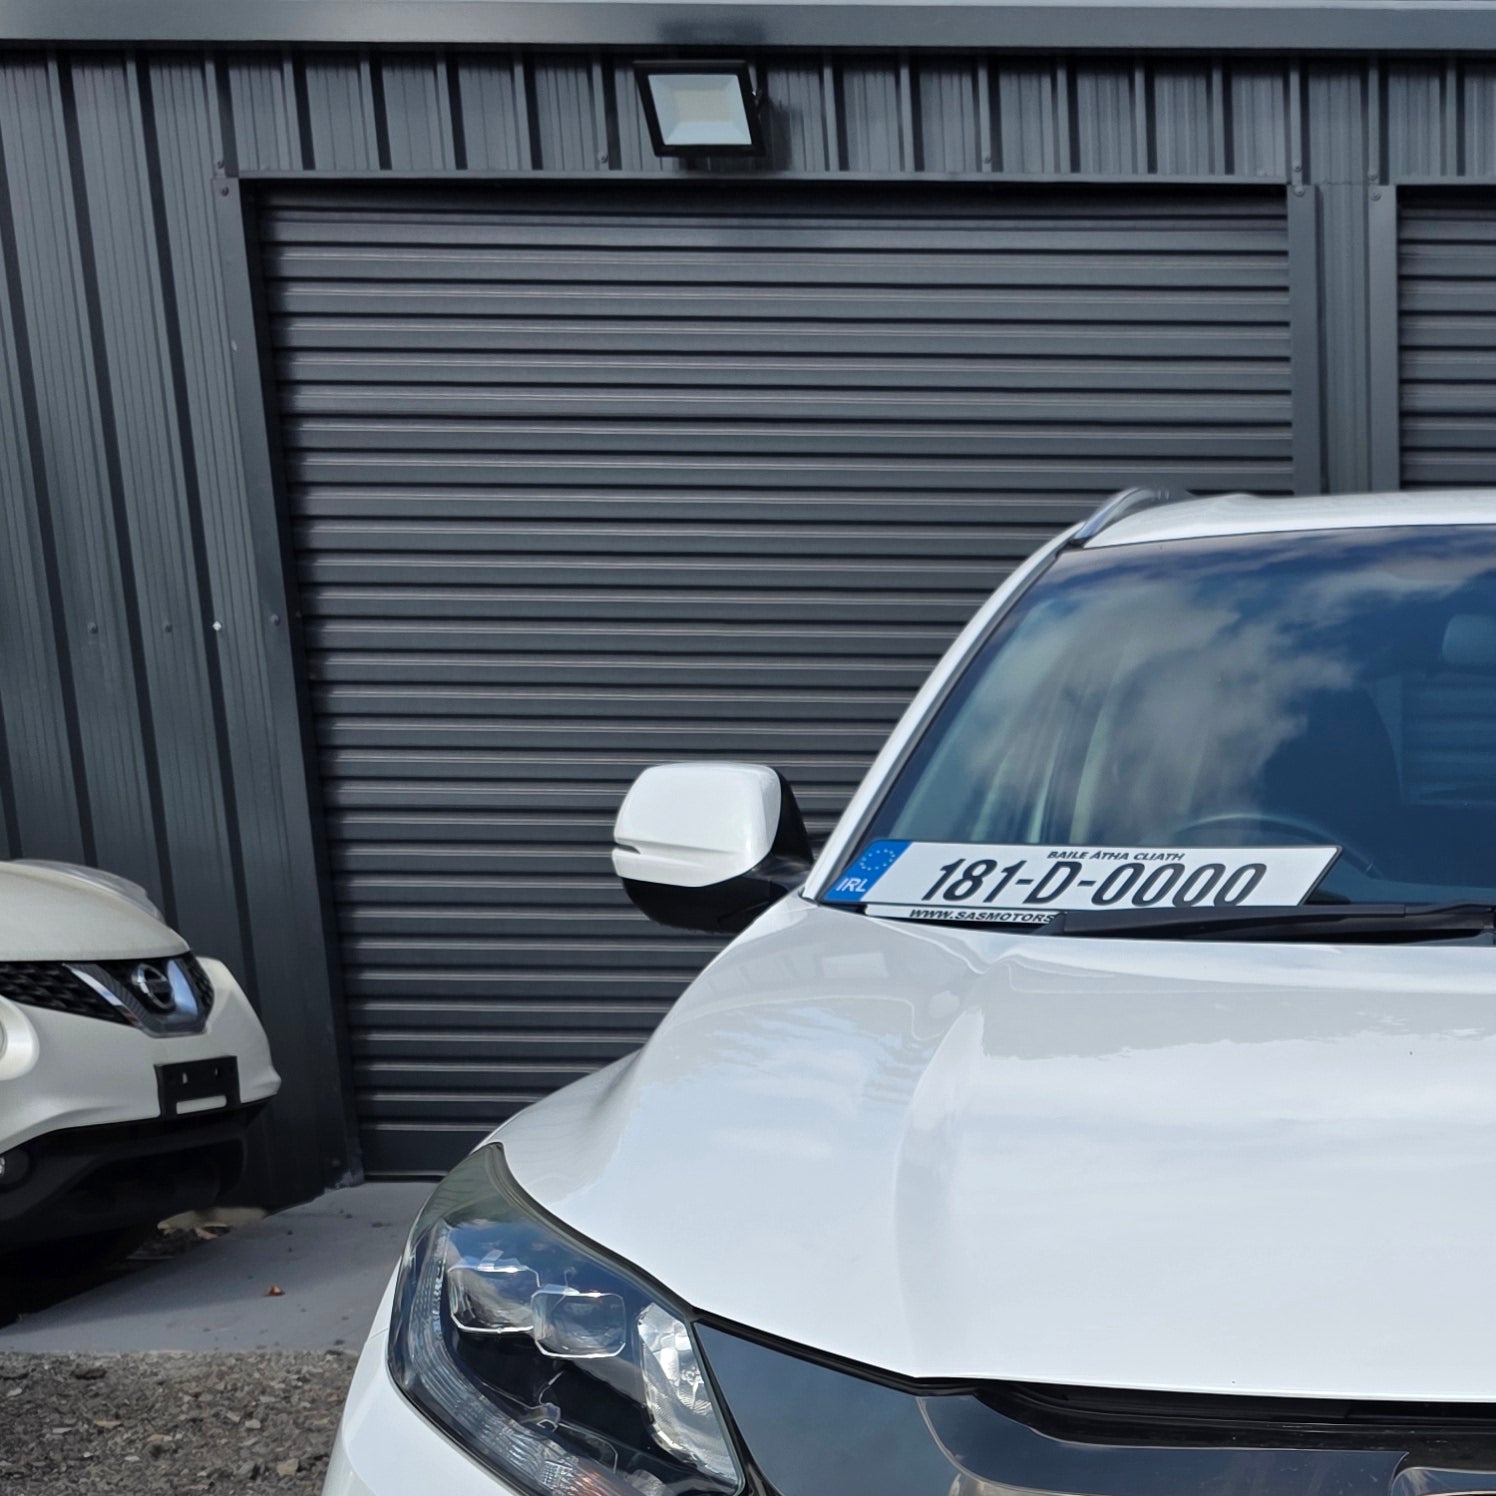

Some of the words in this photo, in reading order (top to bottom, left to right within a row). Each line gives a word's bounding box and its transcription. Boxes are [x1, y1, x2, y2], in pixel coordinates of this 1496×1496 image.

[1047, 851, 1089, 859] BAILE
[1133, 852, 1186, 861] CLIATH
[836, 878, 868, 892] IRL
[921, 858, 1267, 907] 181-D-0000
